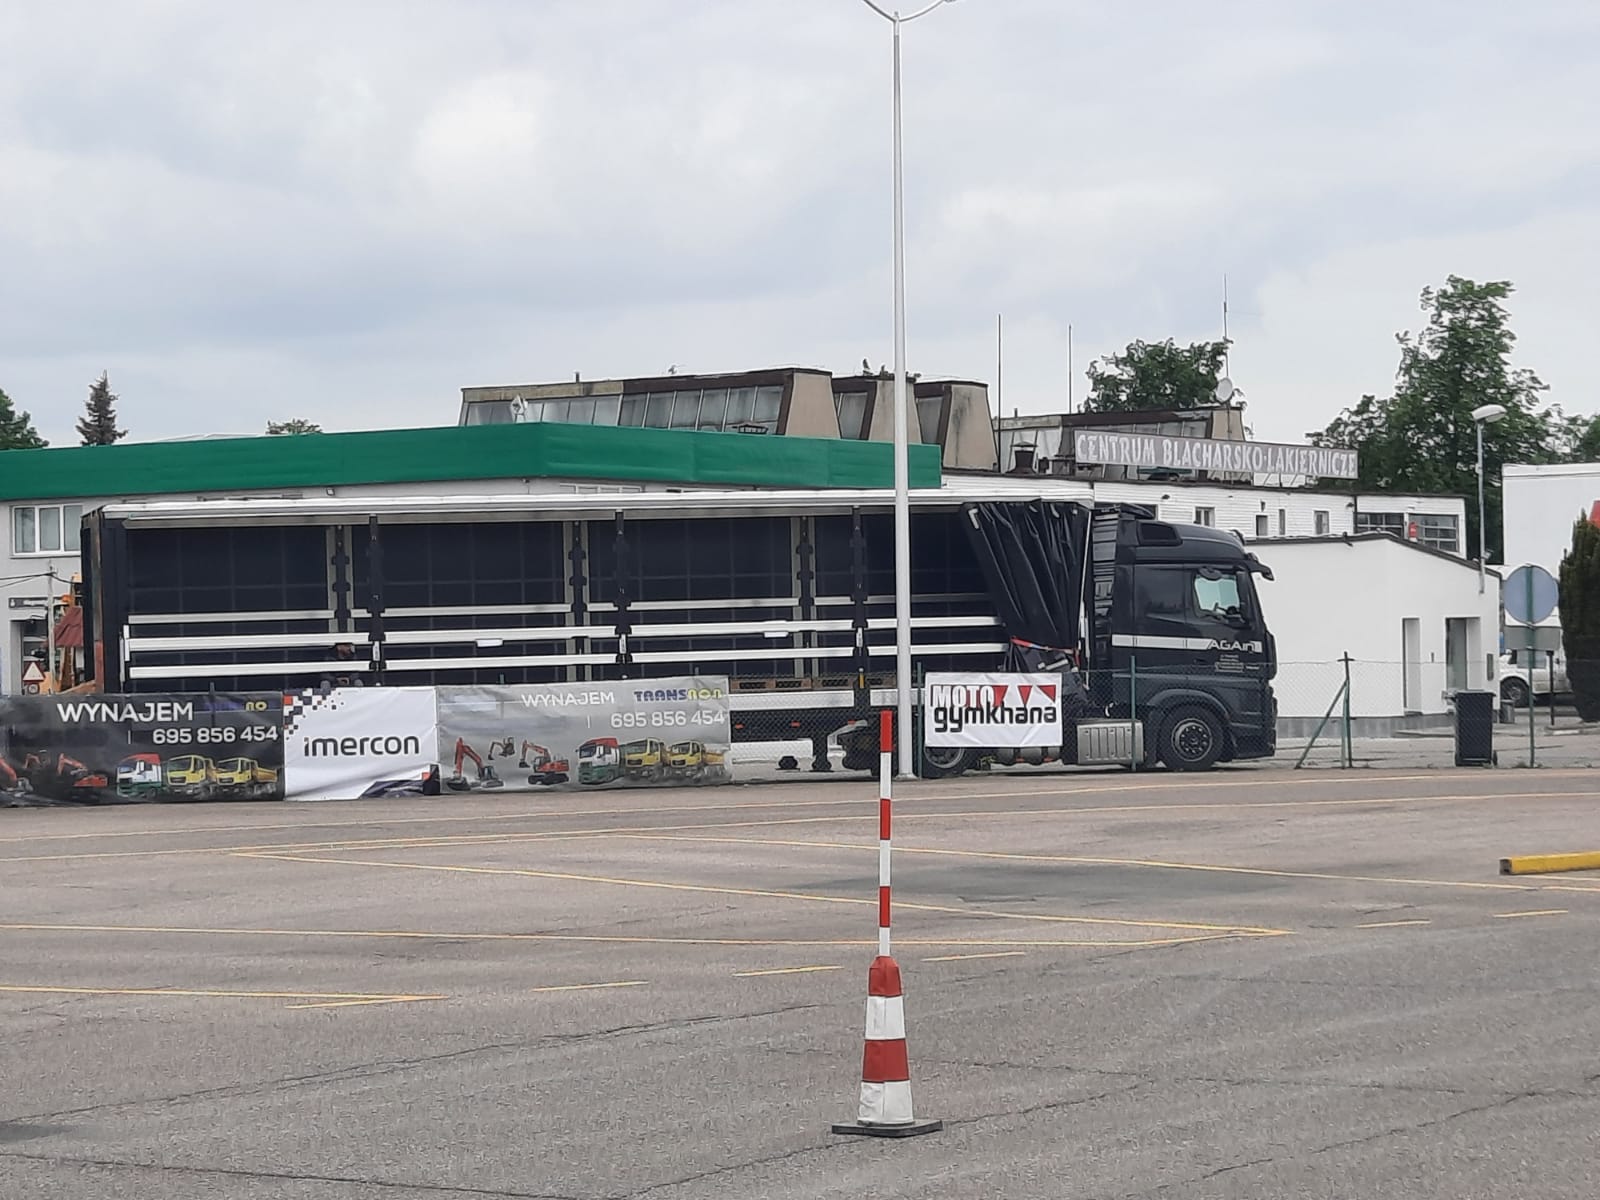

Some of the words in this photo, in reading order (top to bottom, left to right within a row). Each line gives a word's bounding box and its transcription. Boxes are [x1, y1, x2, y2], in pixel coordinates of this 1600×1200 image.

[1077, 434, 1156, 465] CENTRUM
[521, 691, 615, 708] WYNAJEM
[930, 684, 995, 708] MOTO
[56, 702, 193, 723] WYNAJEM
[610, 711, 648, 728] 695
[651, 710, 687, 726] 856
[690, 708, 726, 725] 454
[934, 700, 1057, 733] gymkhana
[152, 728, 192, 745] 695
[196, 727, 236, 744] 856
[240, 725, 278, 742] 454
[303, 735, 420, 757] imercon
